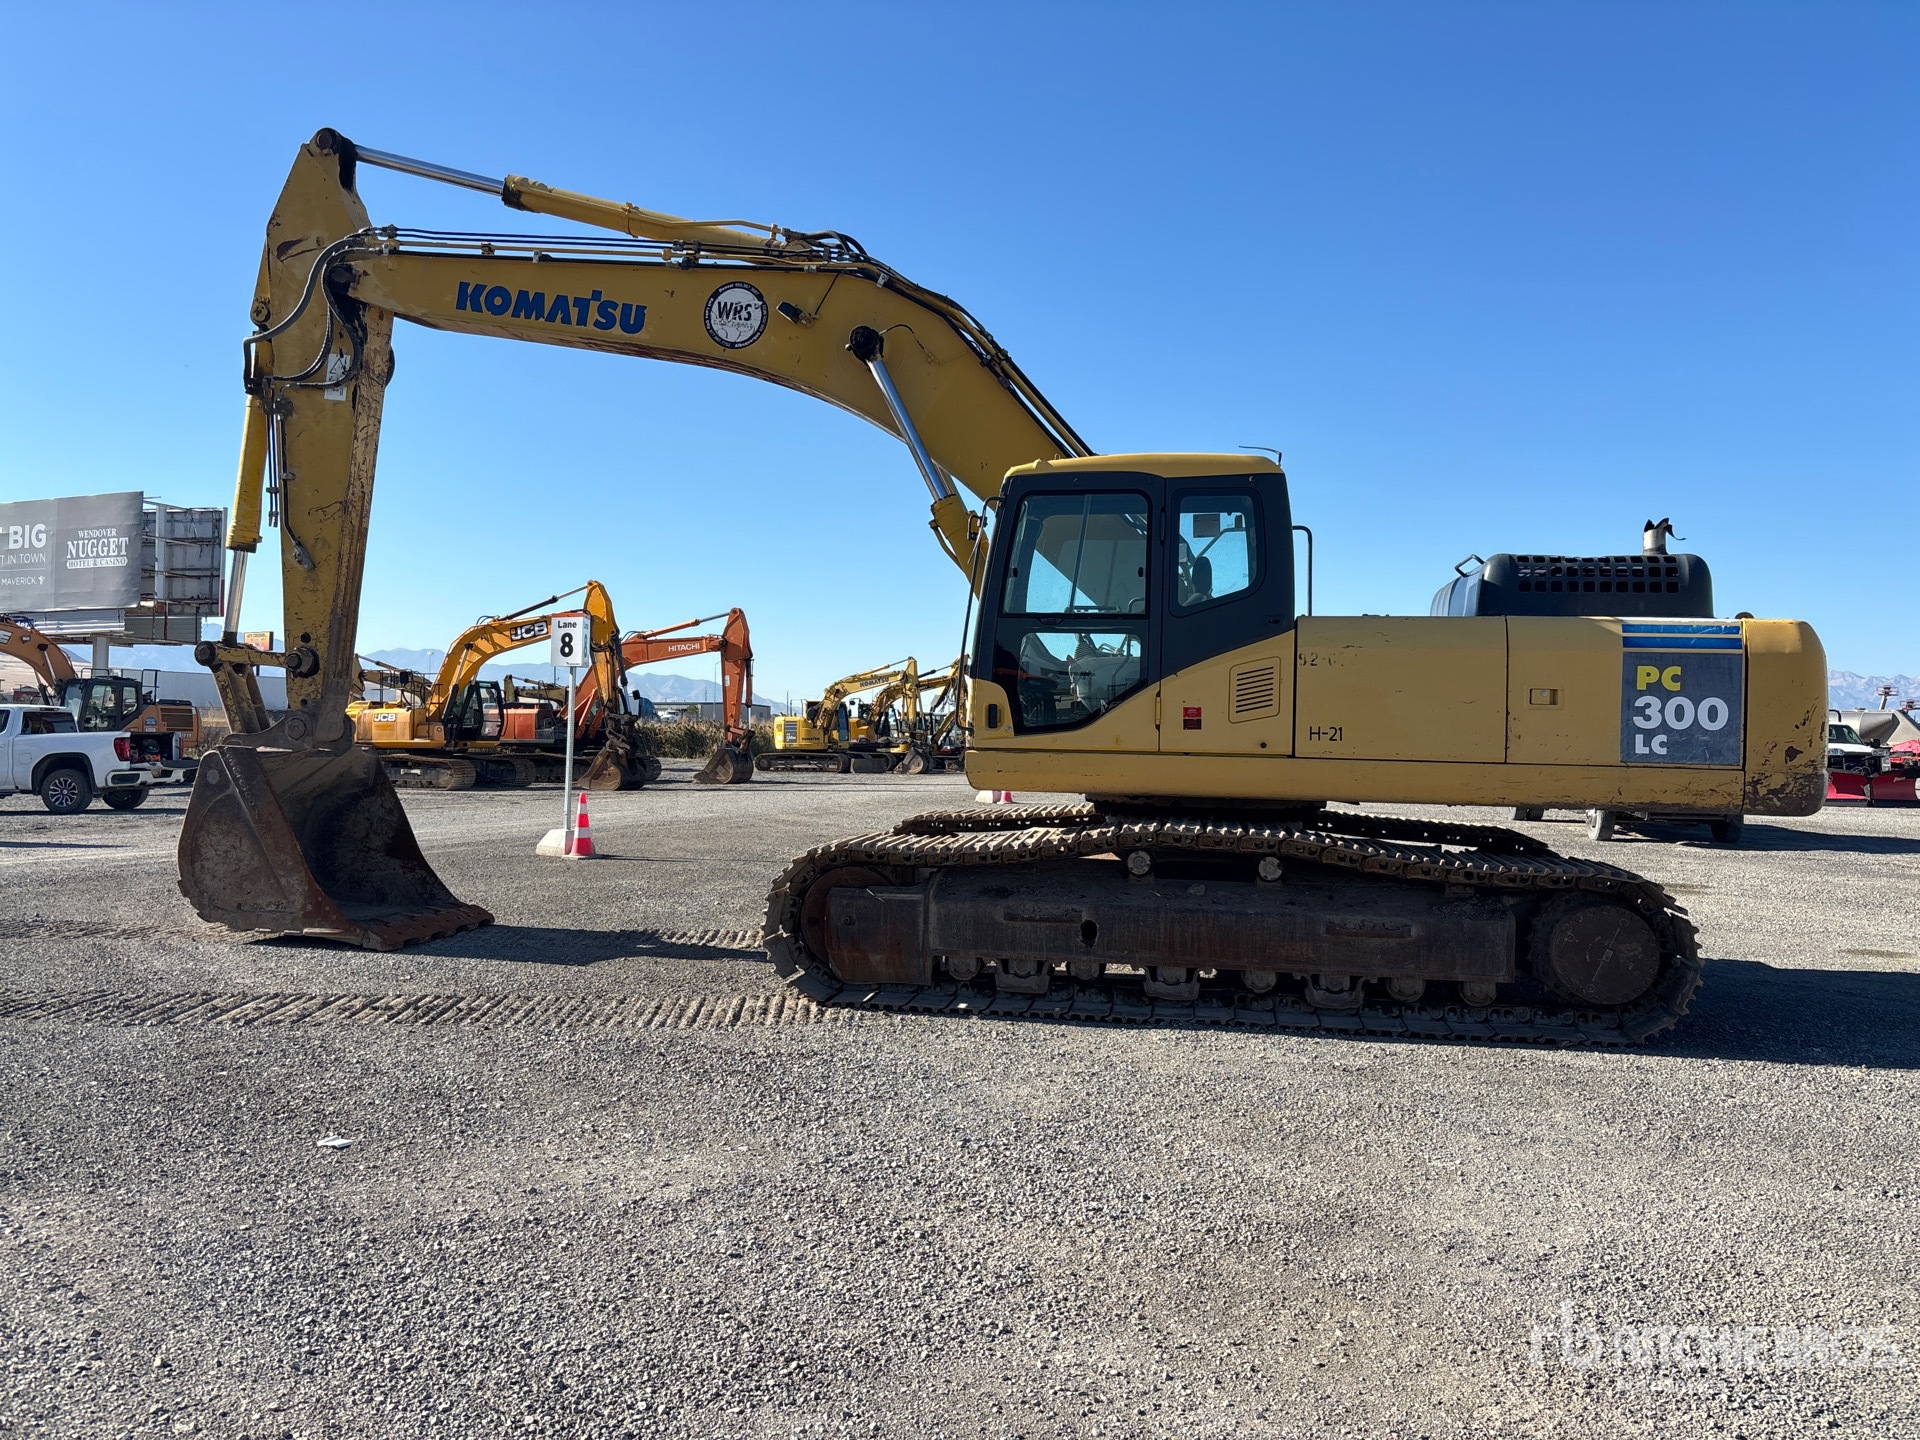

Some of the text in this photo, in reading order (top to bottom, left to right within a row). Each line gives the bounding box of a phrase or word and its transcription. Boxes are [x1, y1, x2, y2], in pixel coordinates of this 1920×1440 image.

[455, 281, 647, 334] KOMATSU
[717, 301, 752, 321] WRS
[8, 523, 46, 549] BIG
[78, 528, 117, 538] WENDOVER
[66, 537, 129, 558] NUGGET
[7, 555, 16, 564] IN
[19, 553, 46, 563] TOWN
[68, 560, 91, 568] HOTEL
[99, 558, 127, 566] CASINO
[511, 621, 548, 640] JCB
[557, 620, 577, 628] Lane
[560, 632, 573, 657] 8
[668, 643, 700, 652] HITACHI
[860, 677, 889, 687] KOMATSU
[1636, 666, 1682, 691] PC
[374, 713, 396, 721] JCB
[1633, 696, 1729, 730] 300
[1309, 727, 1343, 741] H-21
[1635, 734, 1667, 754] LC
